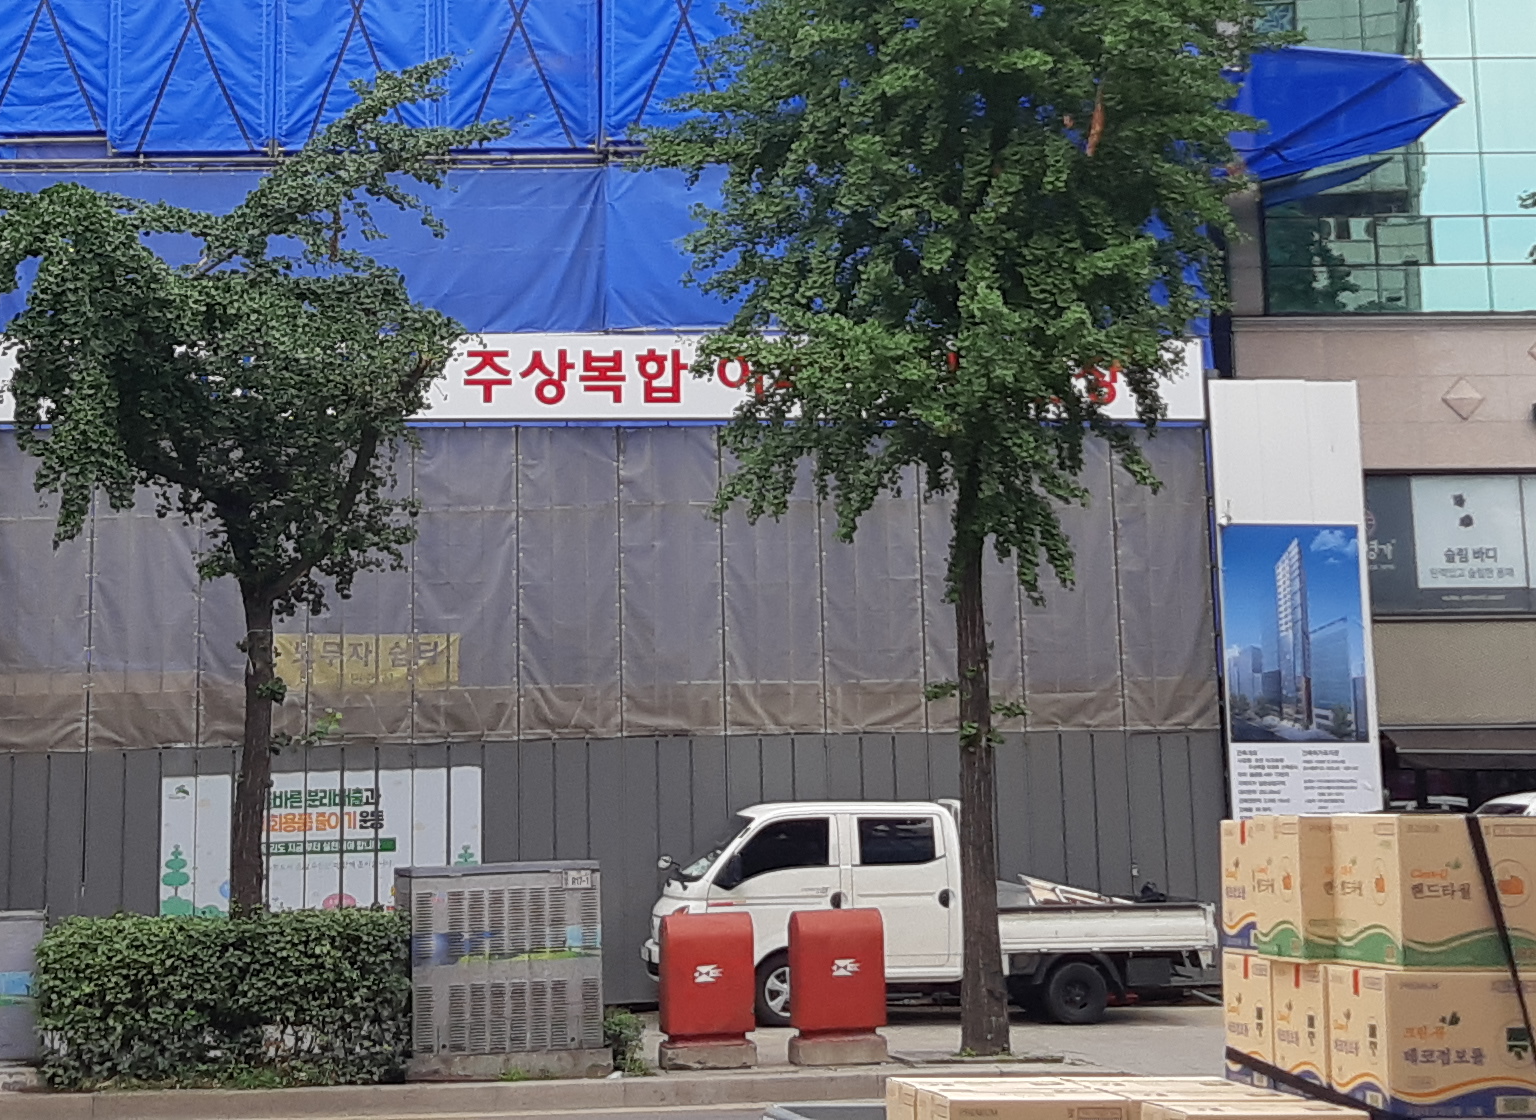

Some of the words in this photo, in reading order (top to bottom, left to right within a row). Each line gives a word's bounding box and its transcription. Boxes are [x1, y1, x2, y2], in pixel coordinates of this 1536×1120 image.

[463, 348, 689, 406] 주상복합
[1473, 546, 1498, 562] 바디
[270, 790, 303, 809] 바른
[263, 812, 313, 833] 회용품
